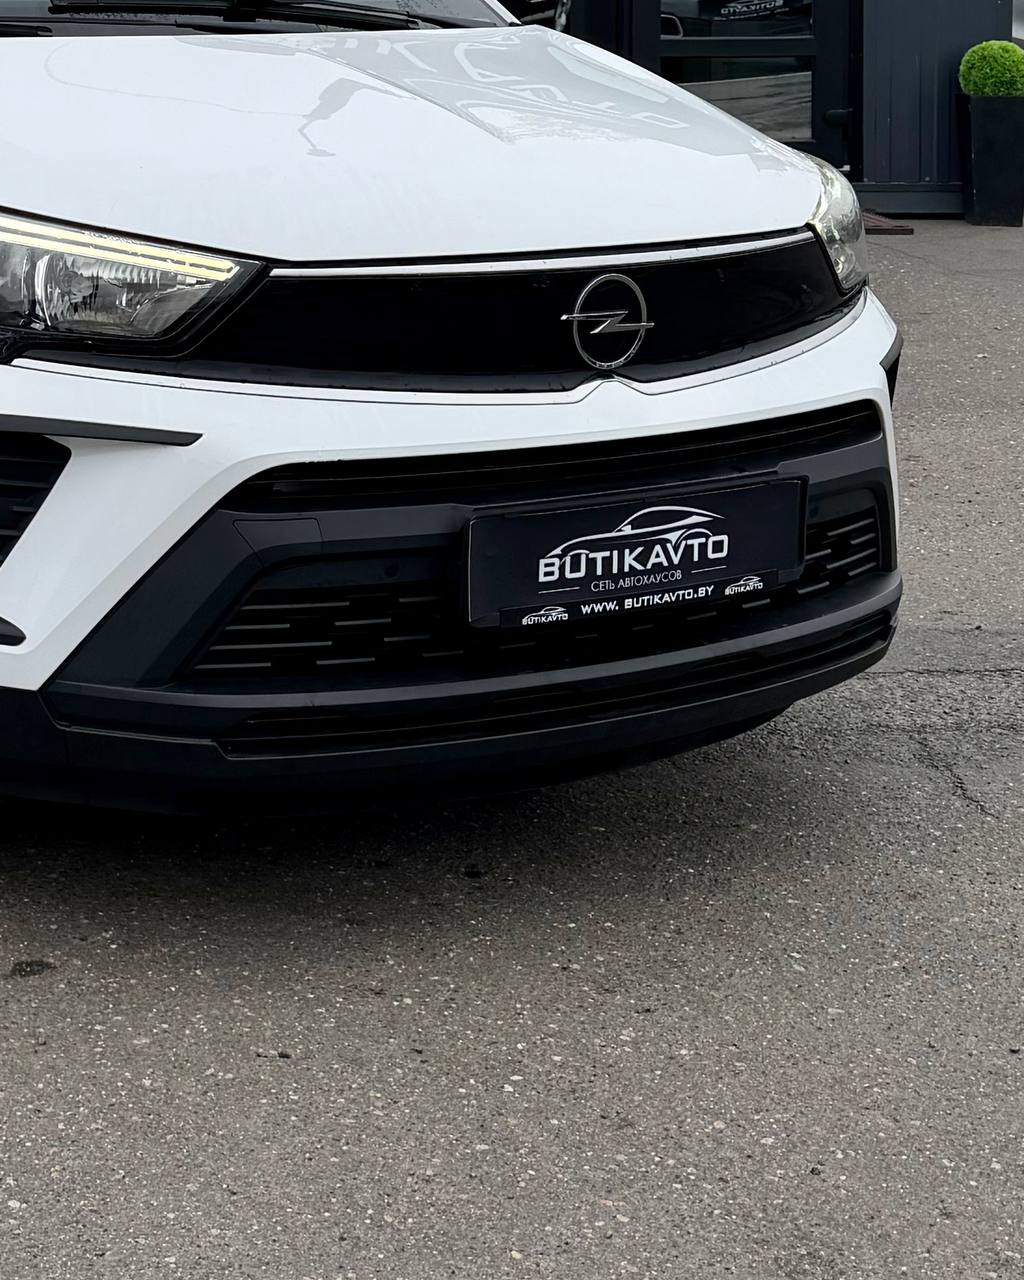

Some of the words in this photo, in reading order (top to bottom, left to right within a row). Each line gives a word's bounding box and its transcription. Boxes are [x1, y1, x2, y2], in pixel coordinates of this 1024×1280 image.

[538, 534, 729, 583] BUTIKAVTO
[590, 580, 616, 592] СЕТЬ
[617, 569, 682, 589] АВТОХАУСОВ
[724, 582, 764, 596] BUTIKAVTO
[580, 600, 619, 615] WWW.
[624, 585, 715, 609] BUTIKAVTO.BY
[521, 613, 569, 626] BUTIKAVTO
